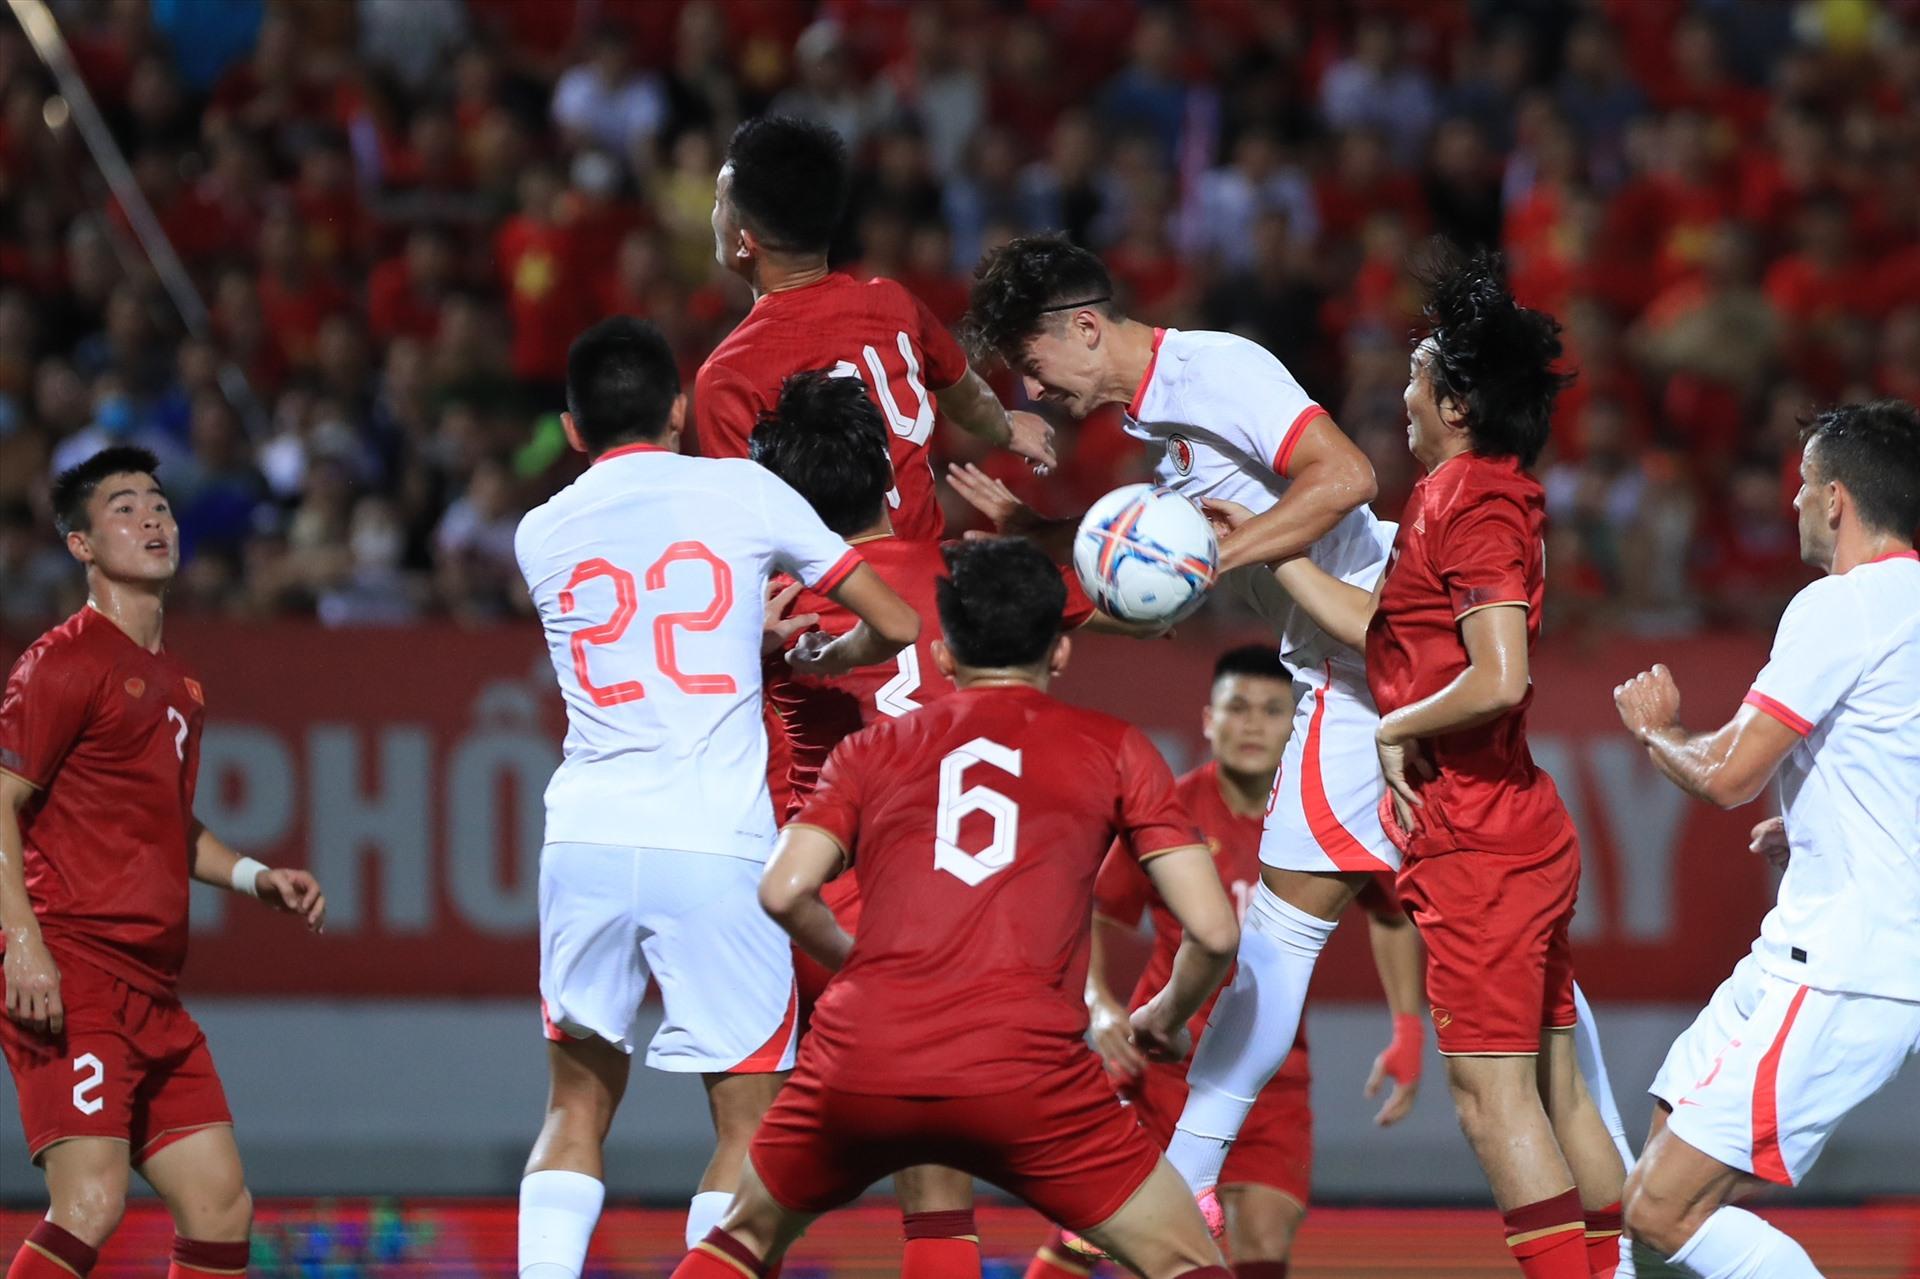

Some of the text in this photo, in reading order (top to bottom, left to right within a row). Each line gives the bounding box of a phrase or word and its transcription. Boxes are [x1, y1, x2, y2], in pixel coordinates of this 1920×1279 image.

[558, 541, 738, 708] 22
[933, 736, 1022, 887] 6
[73, 1052, 104, 1115] 2
